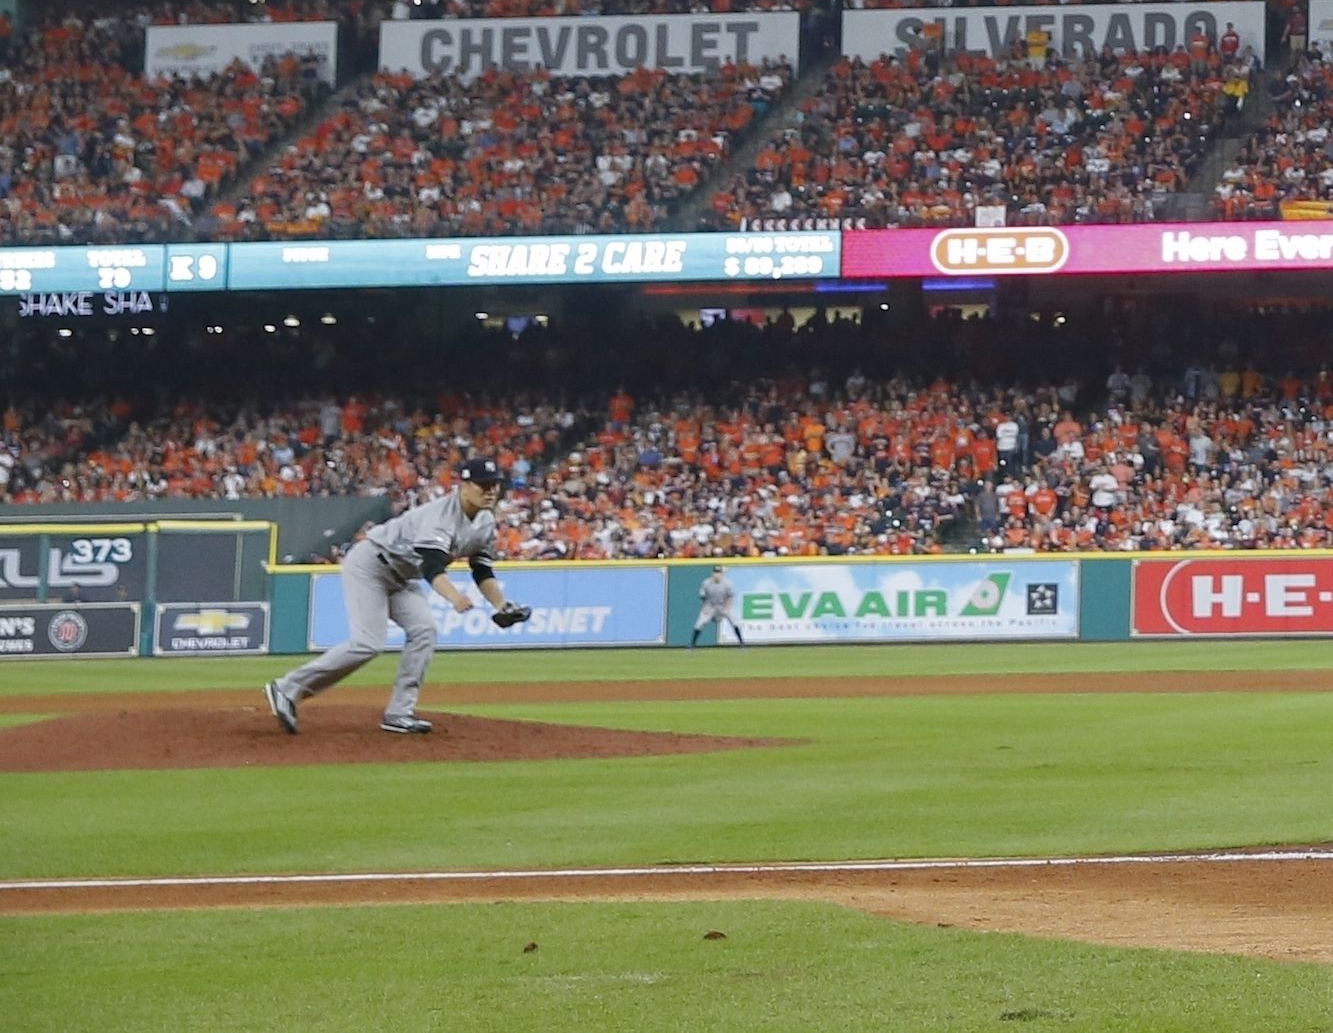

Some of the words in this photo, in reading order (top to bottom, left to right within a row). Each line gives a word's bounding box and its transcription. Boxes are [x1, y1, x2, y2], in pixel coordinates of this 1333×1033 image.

[420, 22, 761, 72] CHEVROLET
[895, 10, 1218, 61] SILVERADO
[468, 245, 569, 276] SHARE
[573, 246, 598, 274] 2
[601, 240, 687, 273] CARE
[1162, 231, 1247, 262] Here
[170, 255, 194, 281] K
[19, 291, 94, 317] SHAKE
[72, 538, 133, 563] 373
[741, 591, 847, 618] EVA
[855, 589, 948, 617] AIR
[171, 636, 251, 650] CHEVROLET
